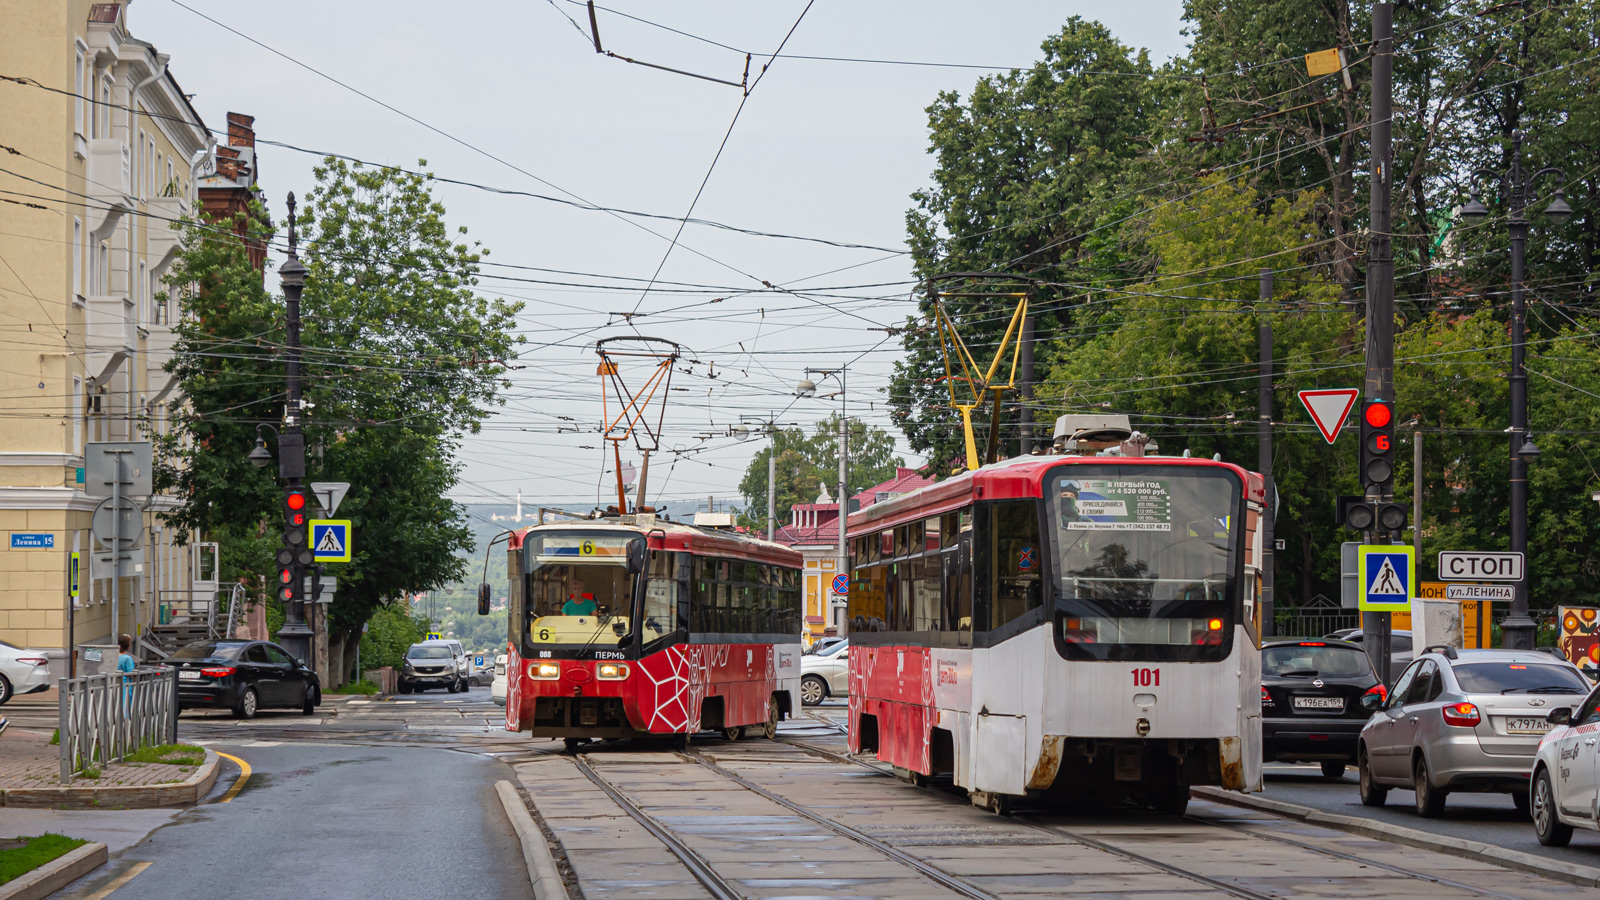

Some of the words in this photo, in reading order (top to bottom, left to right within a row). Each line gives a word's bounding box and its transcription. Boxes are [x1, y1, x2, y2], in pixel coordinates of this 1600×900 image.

[1376, 435, 1390, 450] 16
[1114, 480, 1145, 488] ПЕРВЫЙ
[294, 514, 303, 525] 16
[45, 537, 52, 545] 15
[582, 540, 592, 555] 6
[1450, 557, 1513, 575] СТОП
[539, 628, 549, 640] 6
[595, 651, 625, 659] ПЕРМЬ
[1130, 668, 1160, 687] 101
